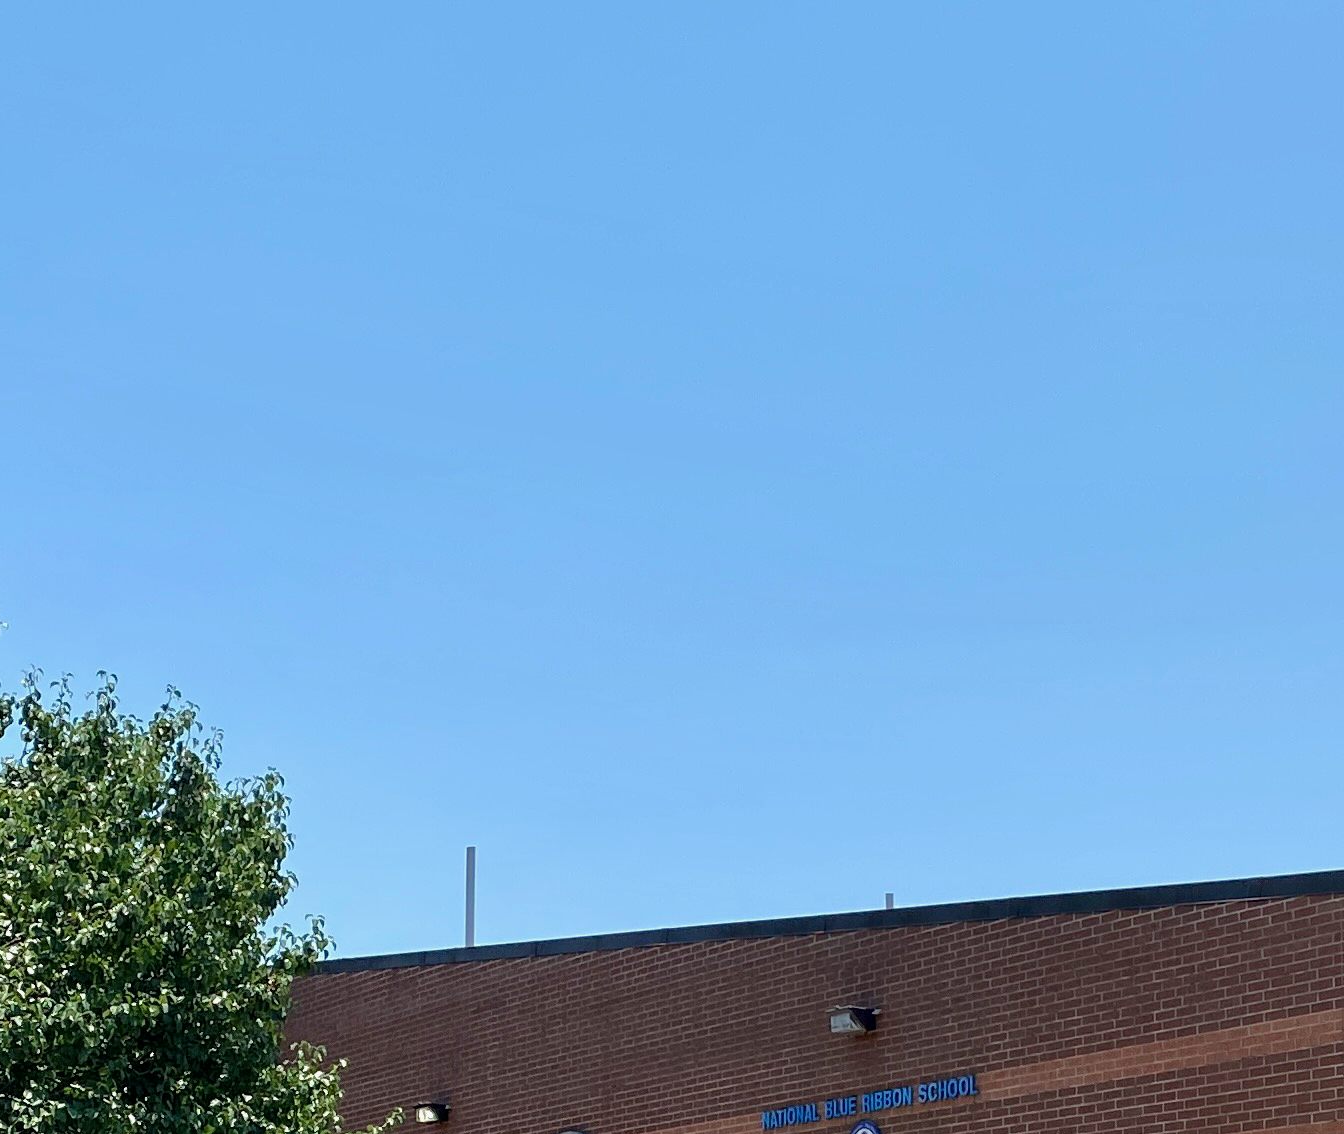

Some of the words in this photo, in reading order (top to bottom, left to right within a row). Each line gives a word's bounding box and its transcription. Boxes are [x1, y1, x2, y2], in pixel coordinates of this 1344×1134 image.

[760, 1103, 820, 1130] NATIONAL
[824, 1095, 857, 1120] BLUE
[861, 1086, 913, 1114] RIBBON
[917, 1074, 978, 1103] SCHOOL
